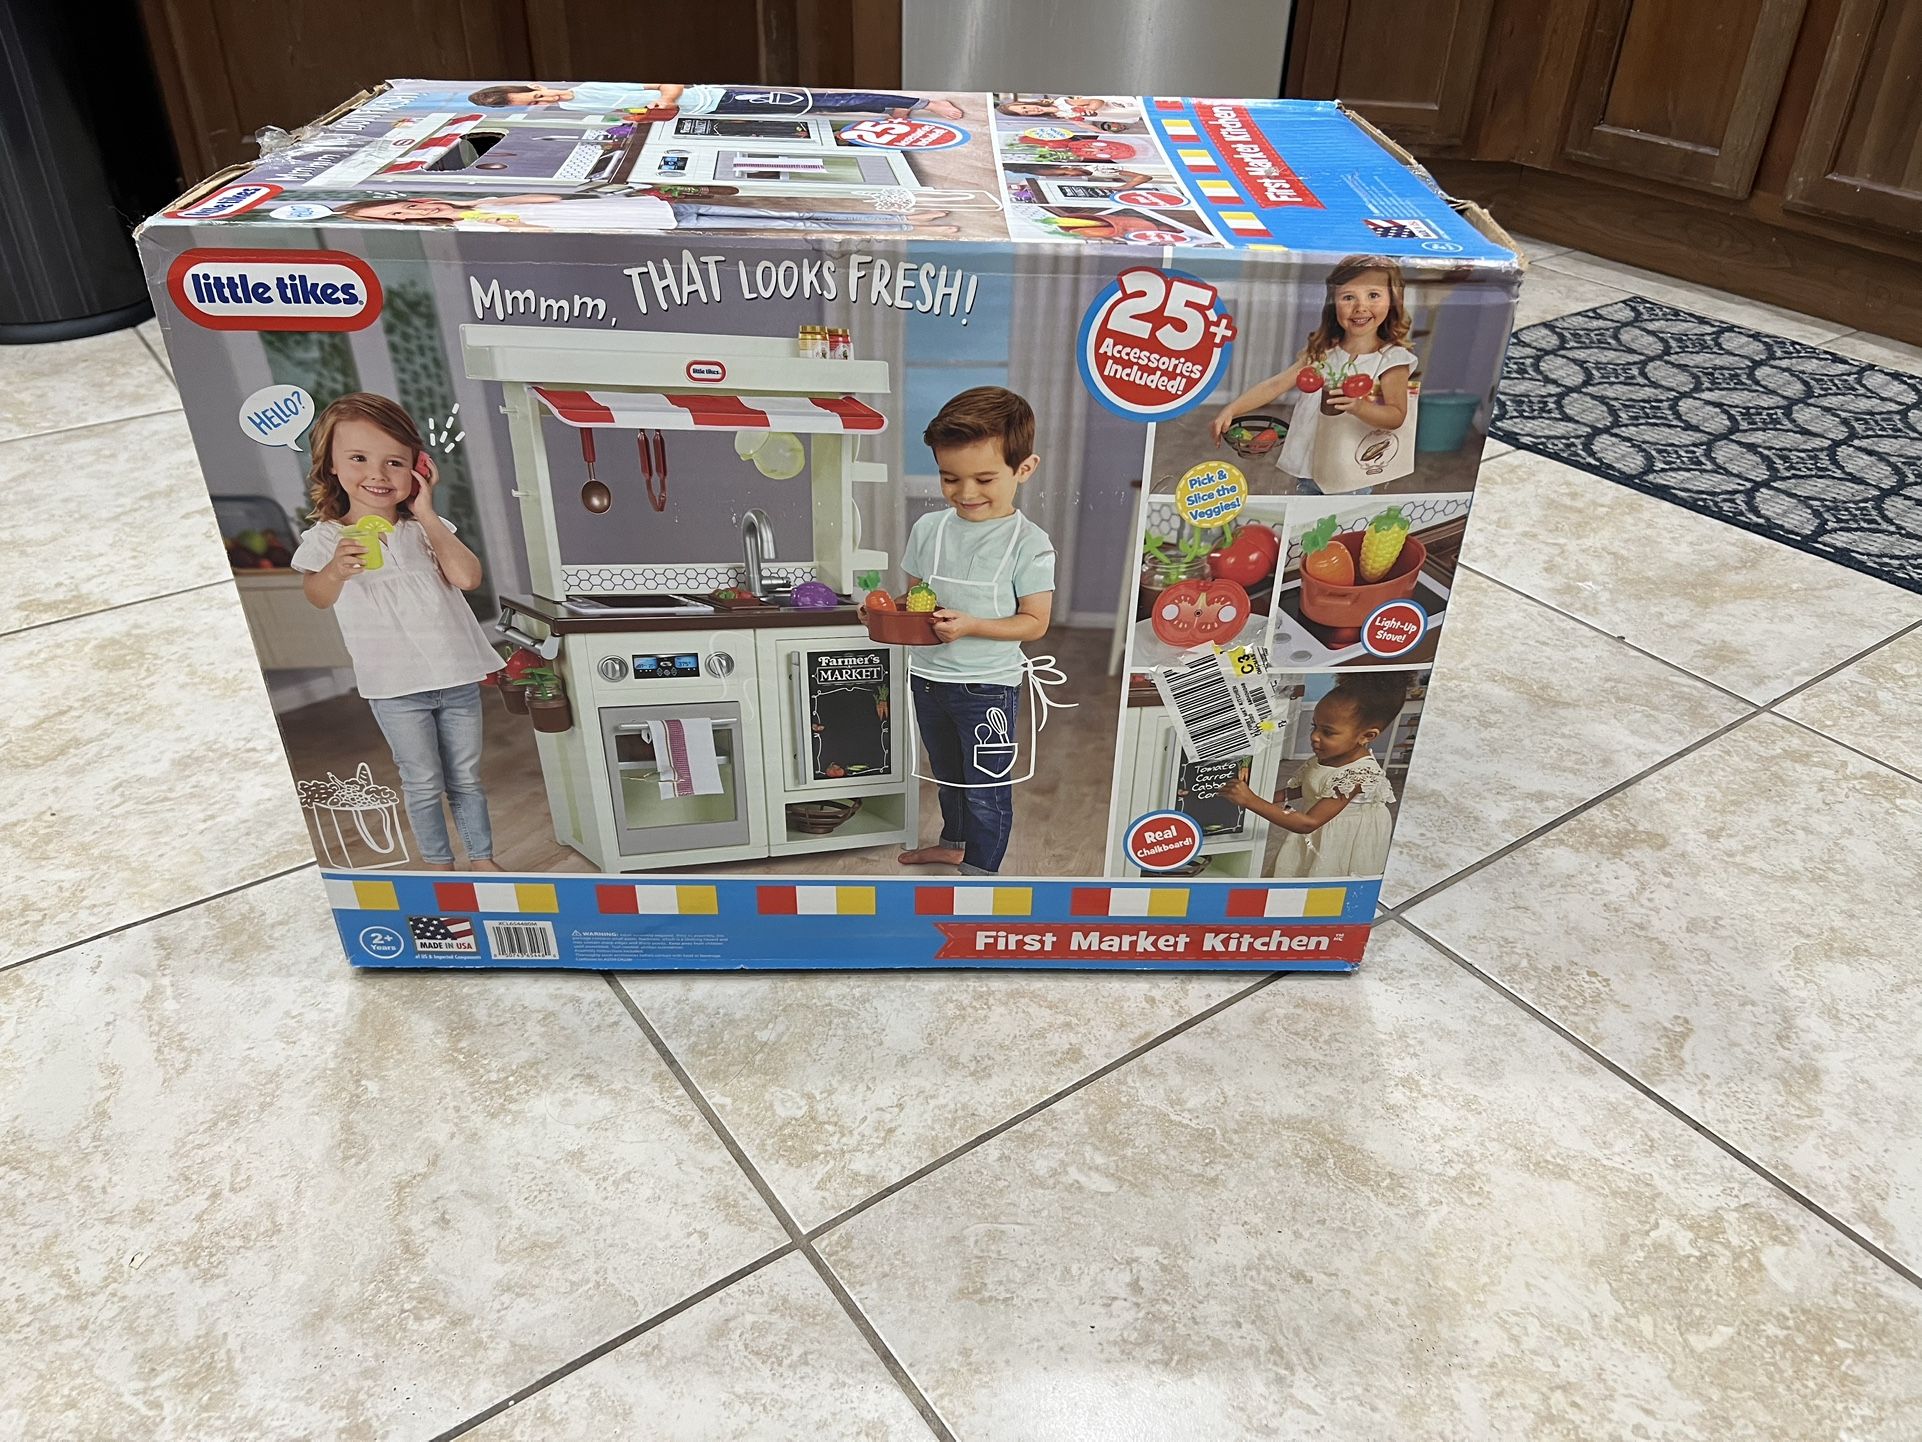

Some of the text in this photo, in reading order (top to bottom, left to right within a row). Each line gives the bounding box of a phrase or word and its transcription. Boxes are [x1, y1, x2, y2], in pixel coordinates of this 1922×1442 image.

[1208, 105, 1303, 202] First Market Kitchen
[191, 272, 361, 306] little tikes
[469, 248, 979, 327] Mmmm, THAT LOOKS FRESH!
[1107, 271, 1232, 351] 25+
[1099, 337, 1203, 379] Accessories
[1104, 359, 1187, 395] Included!
[247, 390, 306, 436] HELLO?
[1188, 469, 1228, 490] Pick &
[1186, 484, 1238, 507] Slice the
[1188, 497, 1241, 521] Veggies!
[1374, 616, 1418, 635] Light-Up
[1375, 630, 1407, 644] Stove!
[818, 653, 881, 667] Farmer's
[1237, 654, 1255, 675] C3
[819, 667, 881, 682] MARKET
[1194, 762, 1237, 774] Tomato
[1195, 772, 1235, 783] Carrot
[1144, 825, 1177, 844] Real
[1136, 837, 1193, 858] Chalkboard!
[370, 932, 393, 944] 2+
[420, 941, 443, 949] MADE
[456, 942, 473, 950] USA
[974, 930, 1330, 953] First Market Kitchen
